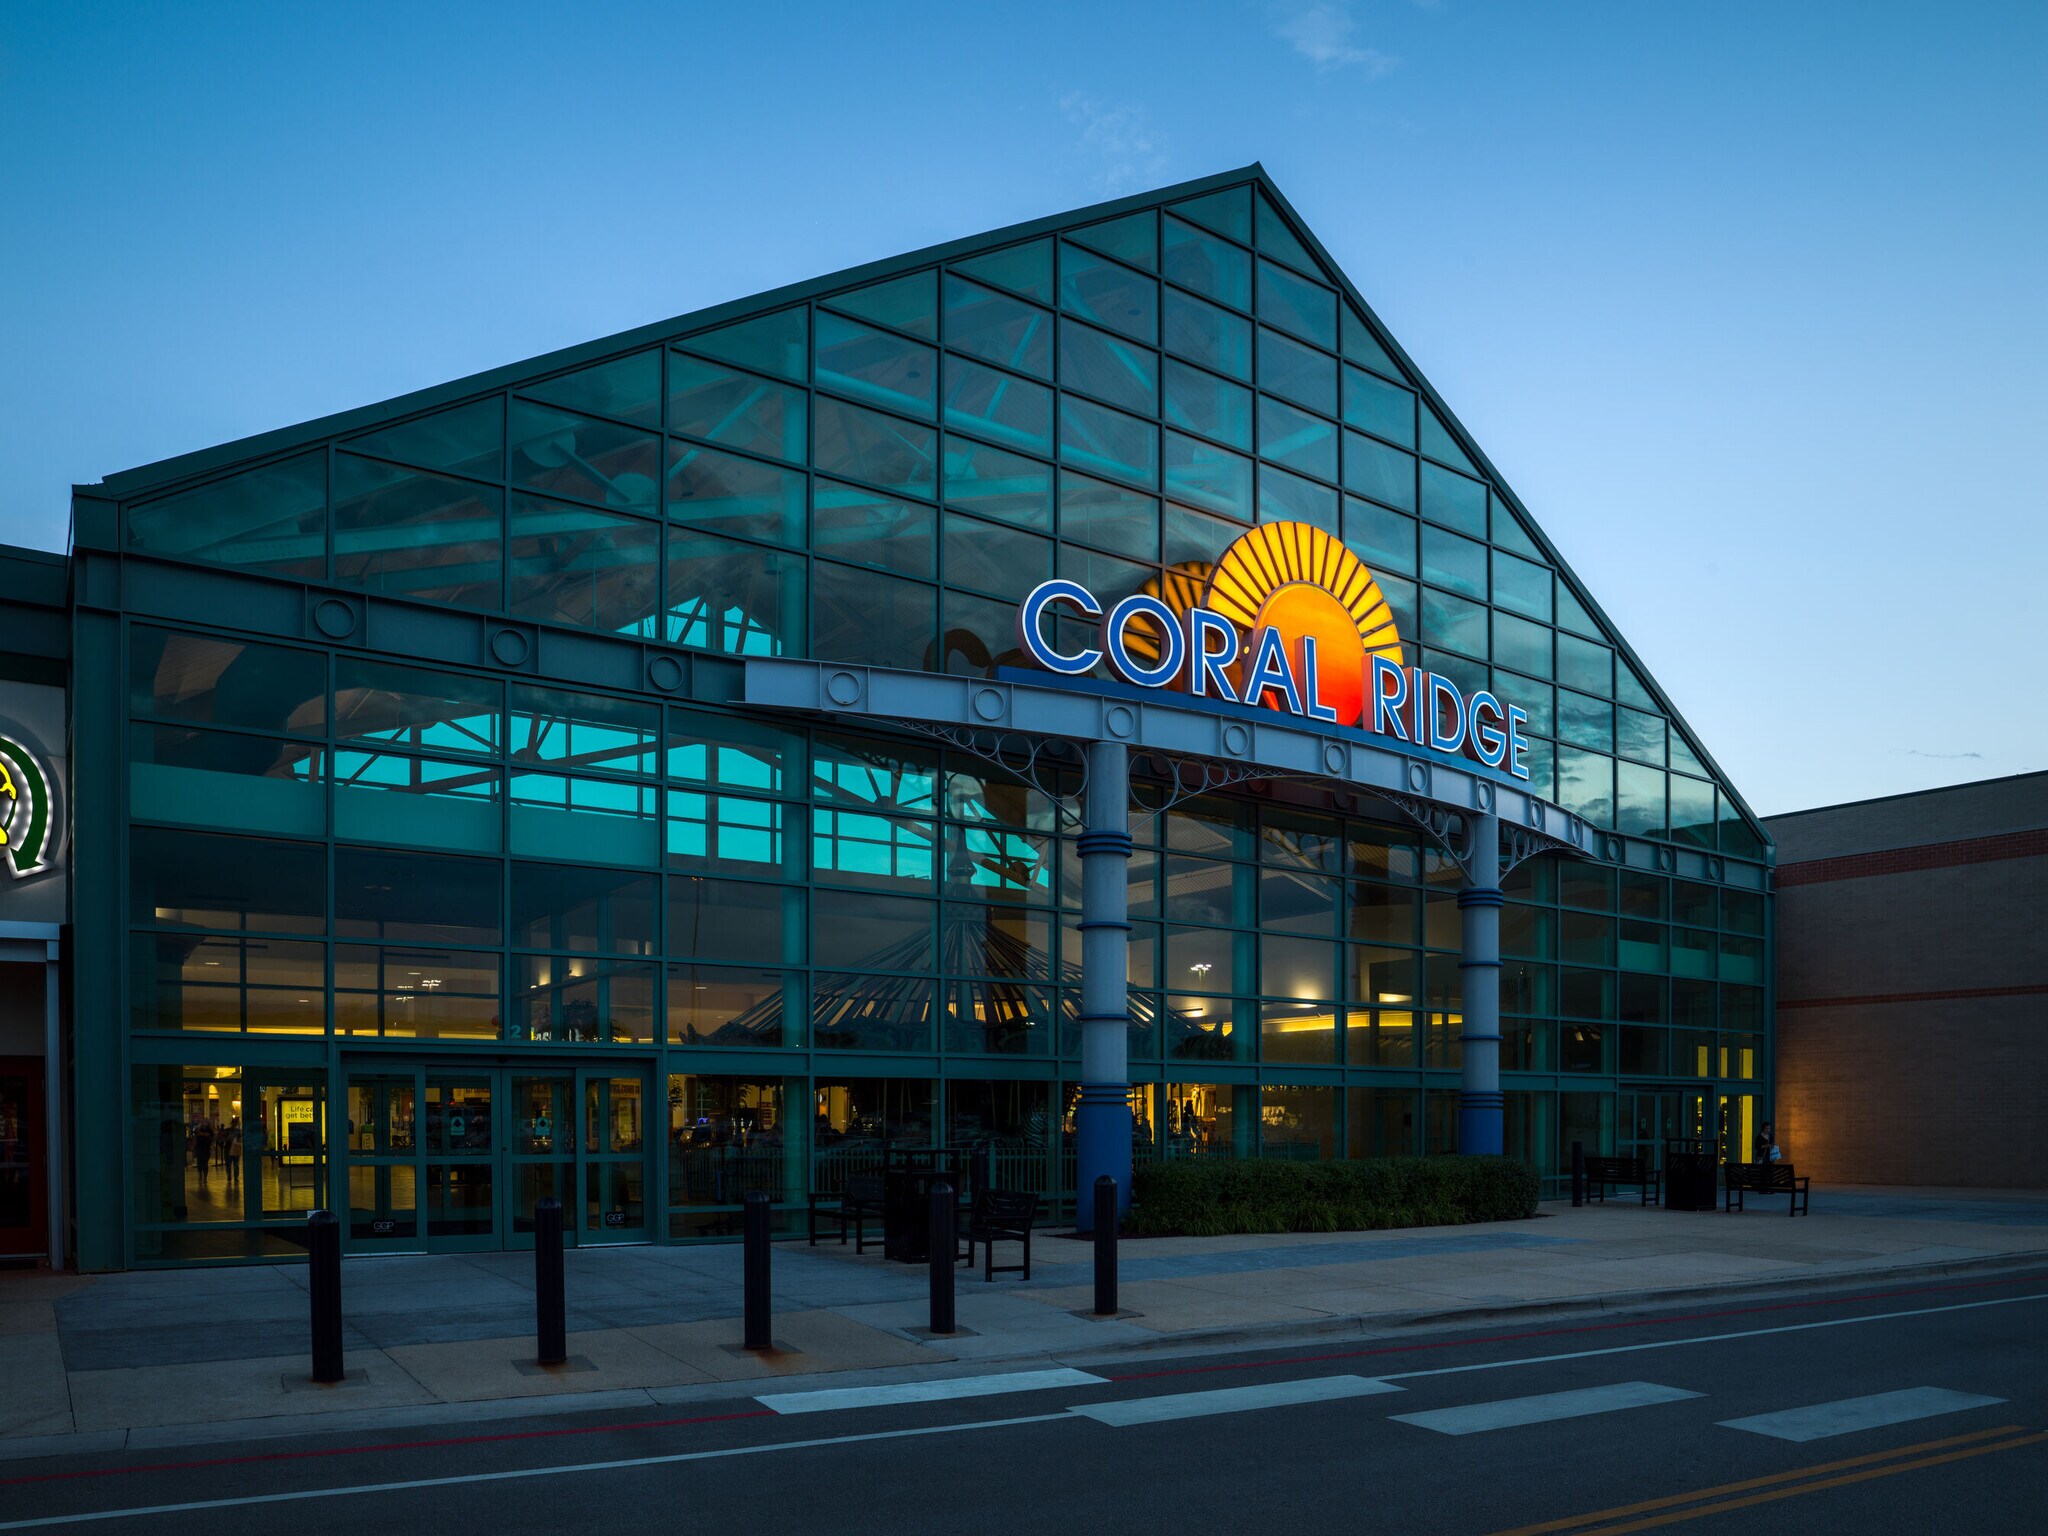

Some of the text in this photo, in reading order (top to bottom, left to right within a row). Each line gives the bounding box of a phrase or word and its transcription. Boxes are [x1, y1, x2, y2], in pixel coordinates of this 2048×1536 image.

[1017, 578, 1530, 781] CORAL RIDGE
[510, 1025, 522, 1038] 2
